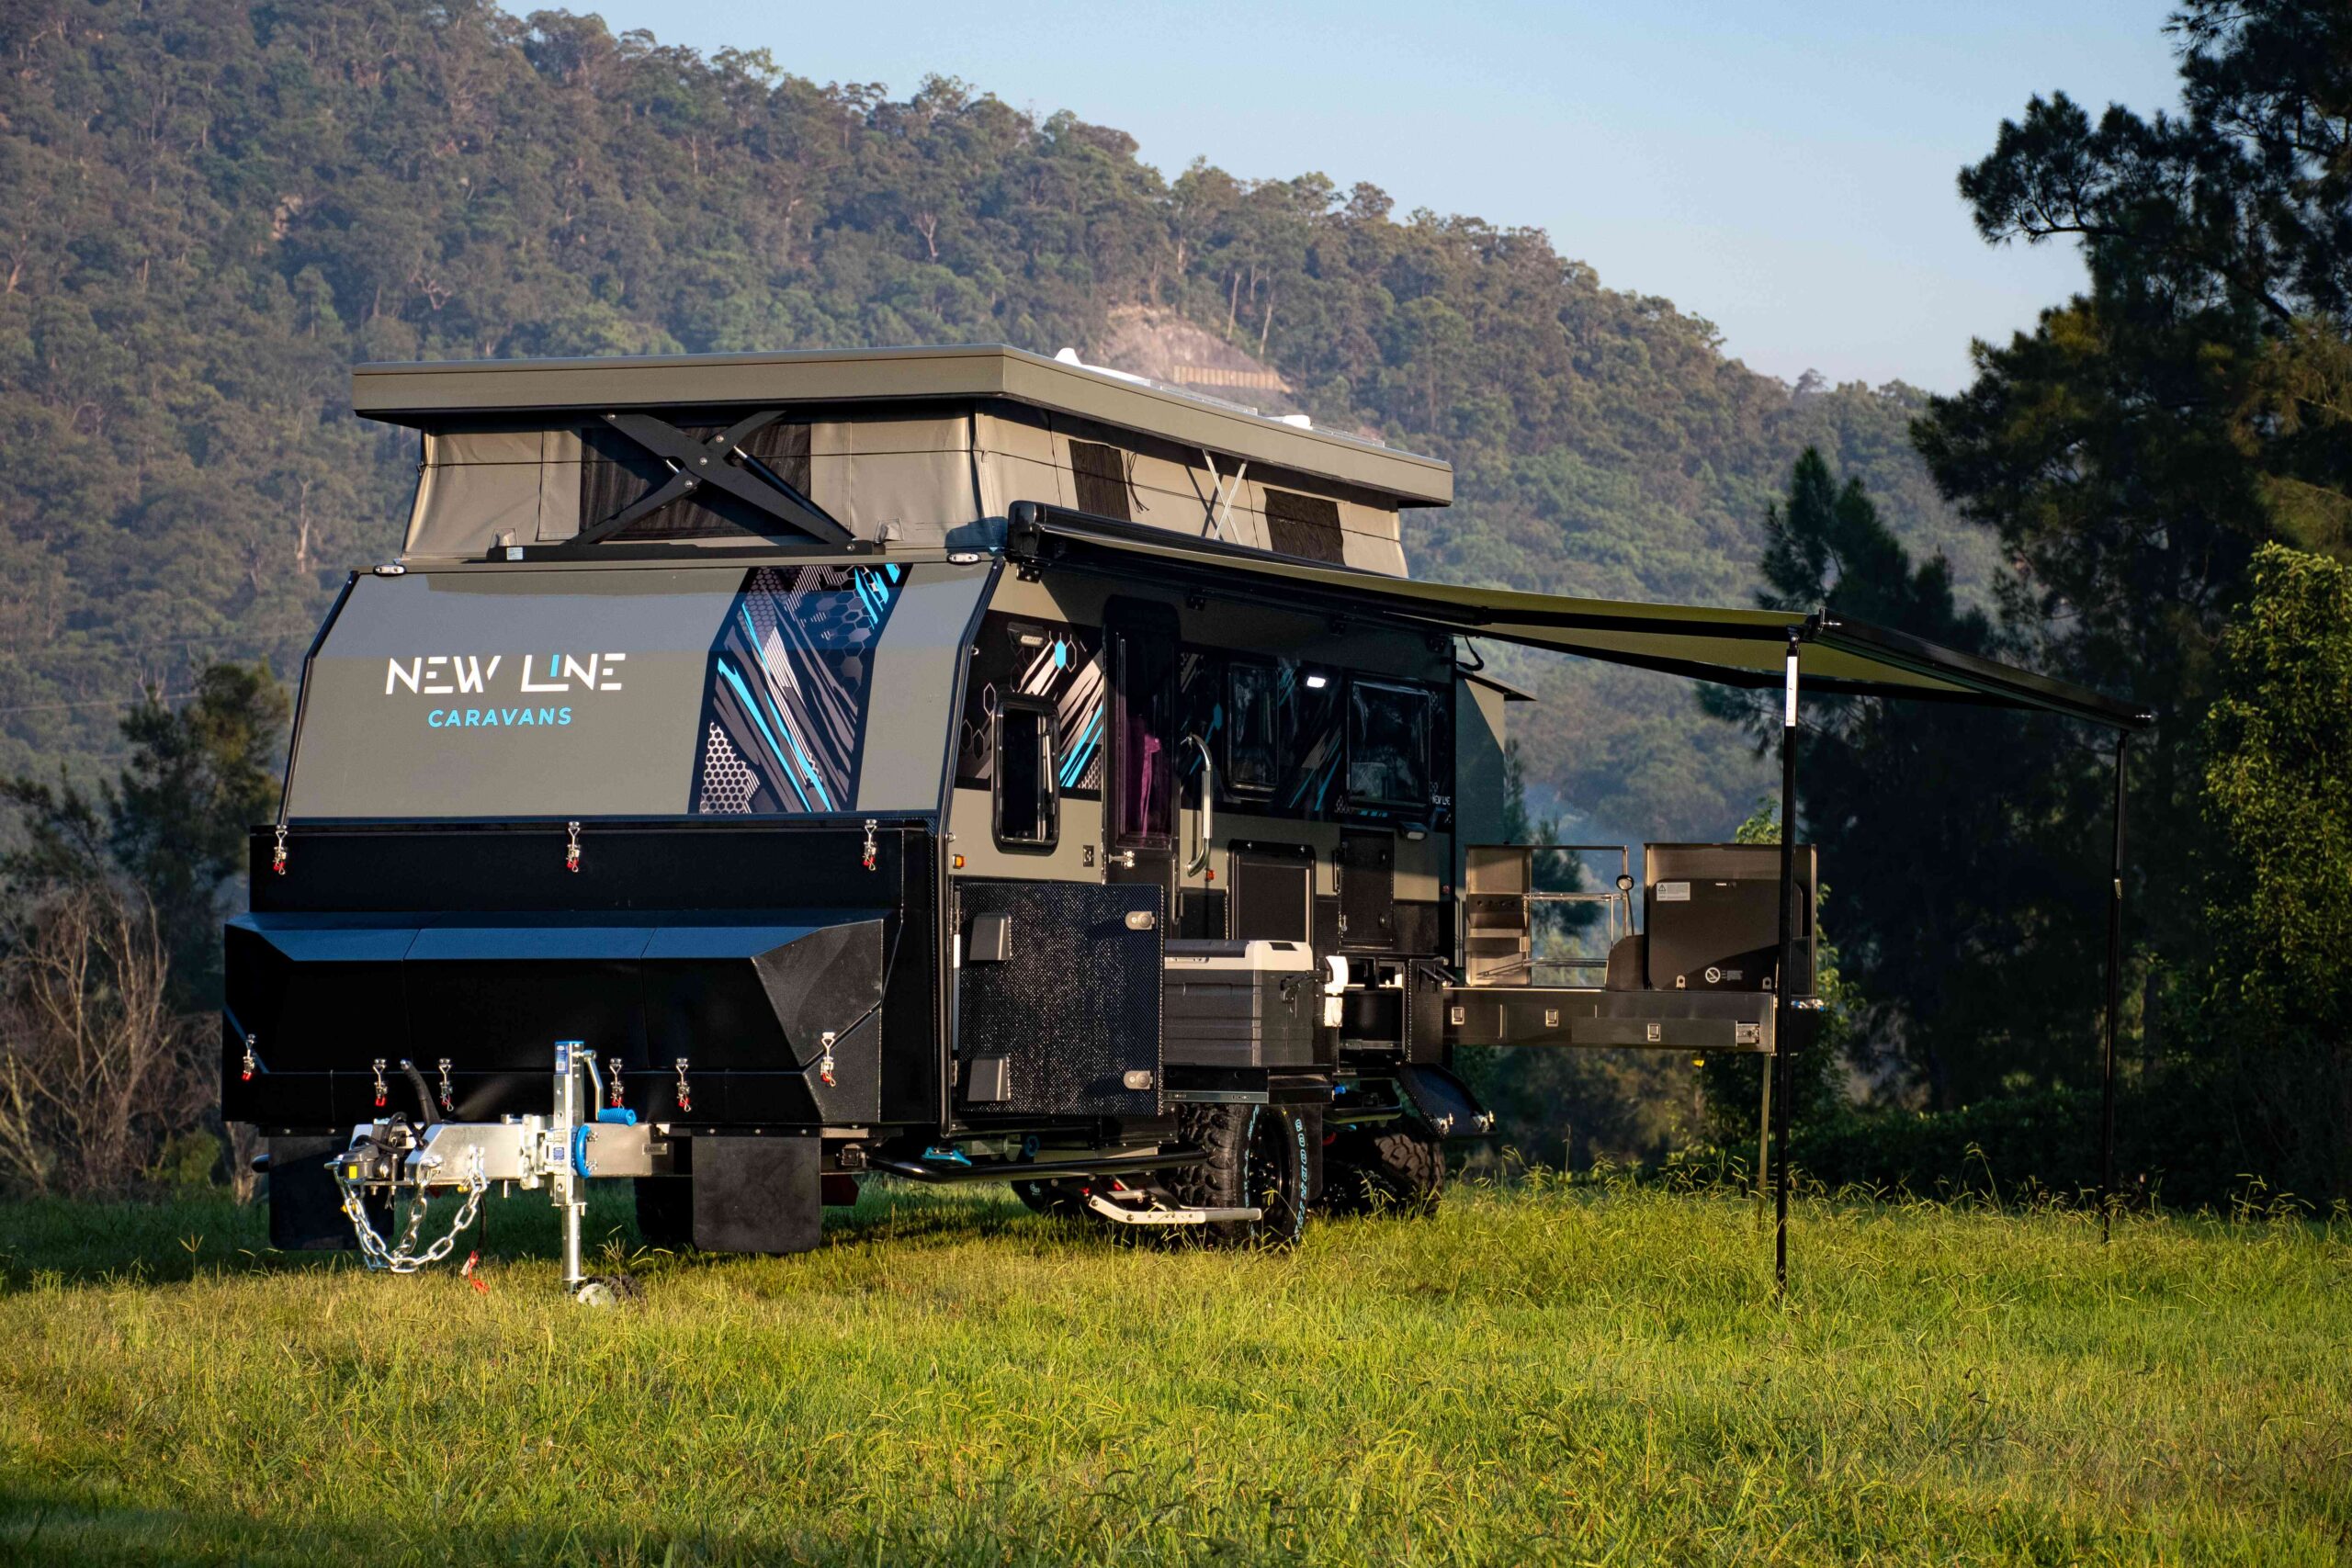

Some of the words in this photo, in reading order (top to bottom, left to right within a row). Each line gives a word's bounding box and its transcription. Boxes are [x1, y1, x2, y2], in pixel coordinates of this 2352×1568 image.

[385, 655, 502, 695] NEW
[520, 652, 627, 693] LINE
[427, 706, 572, 728] CARAVANS
